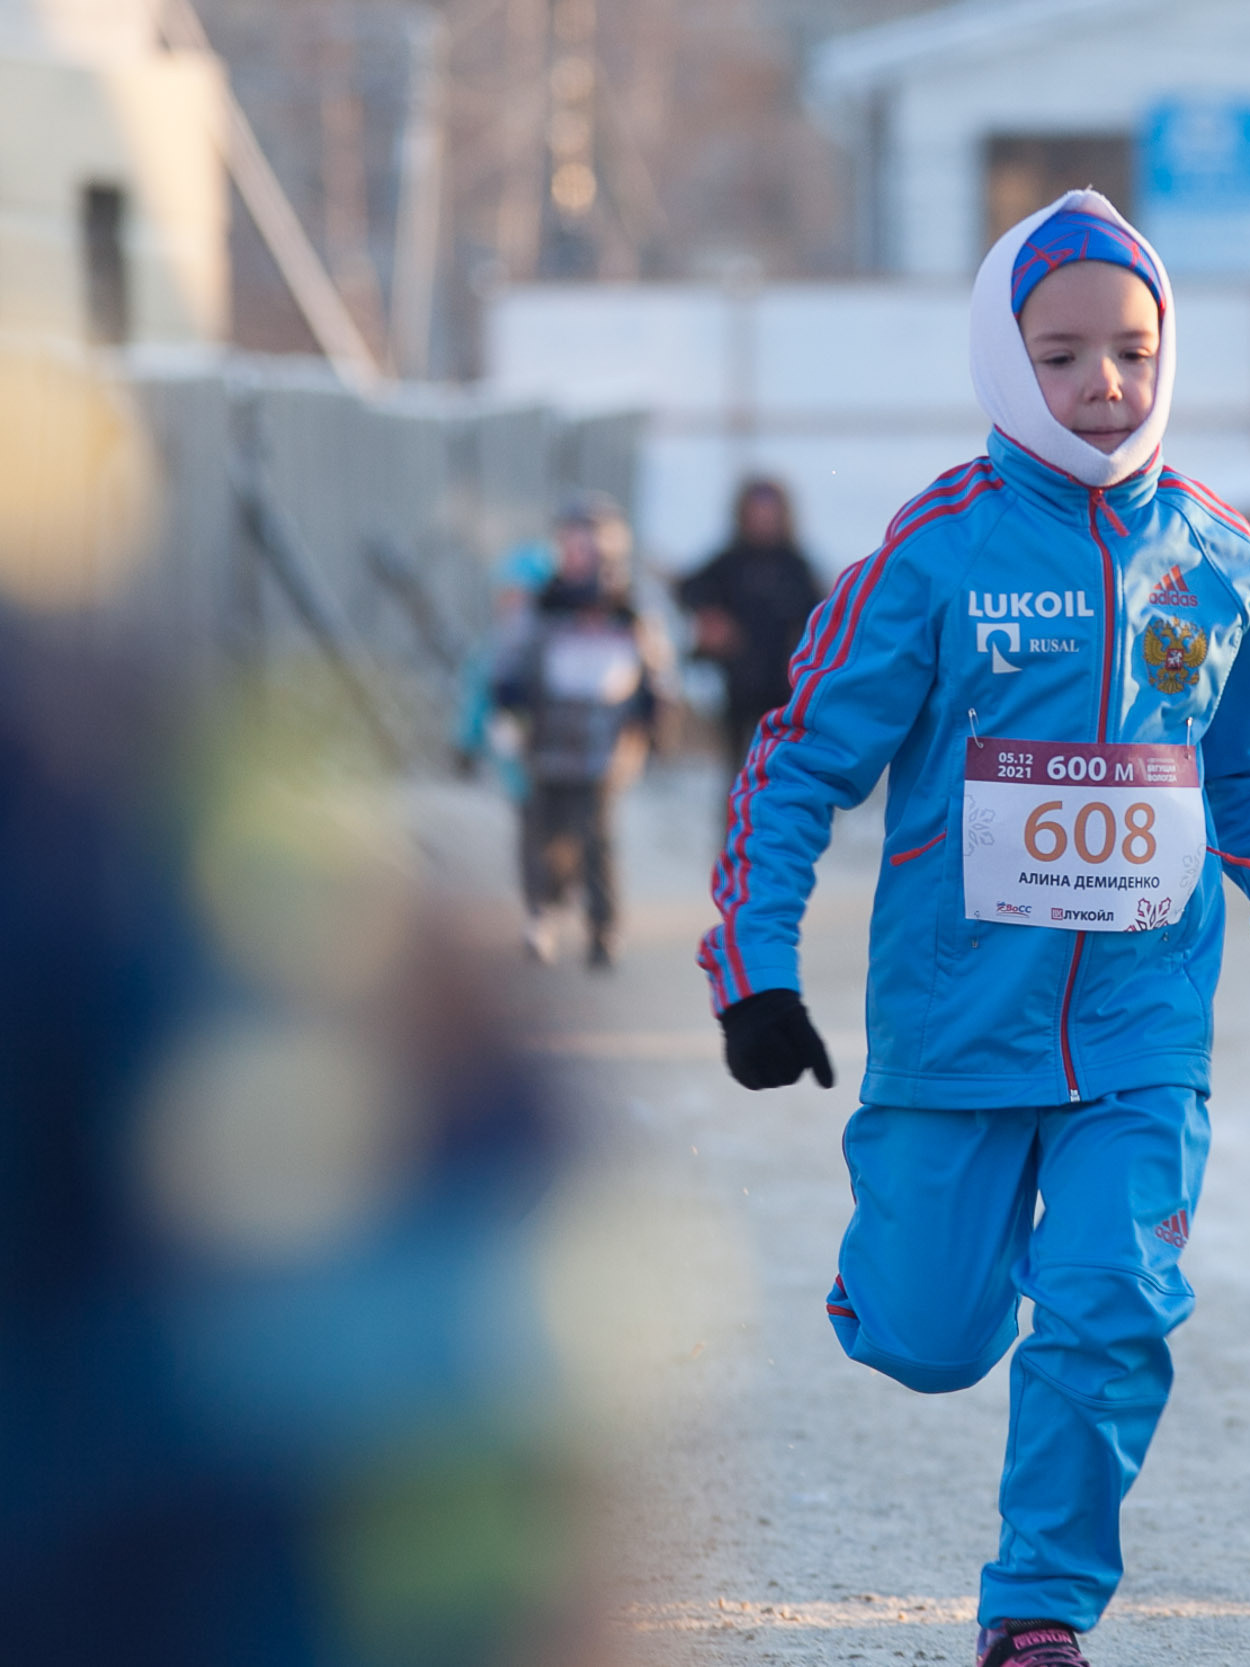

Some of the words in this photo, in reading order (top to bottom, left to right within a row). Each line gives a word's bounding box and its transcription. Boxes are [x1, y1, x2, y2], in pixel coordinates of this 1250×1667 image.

[968, 590, 1094, 618] LUKOIL
[1149, 590, 1199, 607] adidas
[1029, 639, 1079, 652] RUSAL
[998, 752, 1034, 765] 05.12
[997, 765, 1032, 779] 2021
[1046, 755, 1107, 782] 600
[1024, 801, 1157, 864] 608
[1018, 872, 1071, 887] АЛИНА
[1073, 875, 1160, 891] ДЕМИДЕНКО
[1064, 909, 1114, 922] ЛУКОЙЛ
